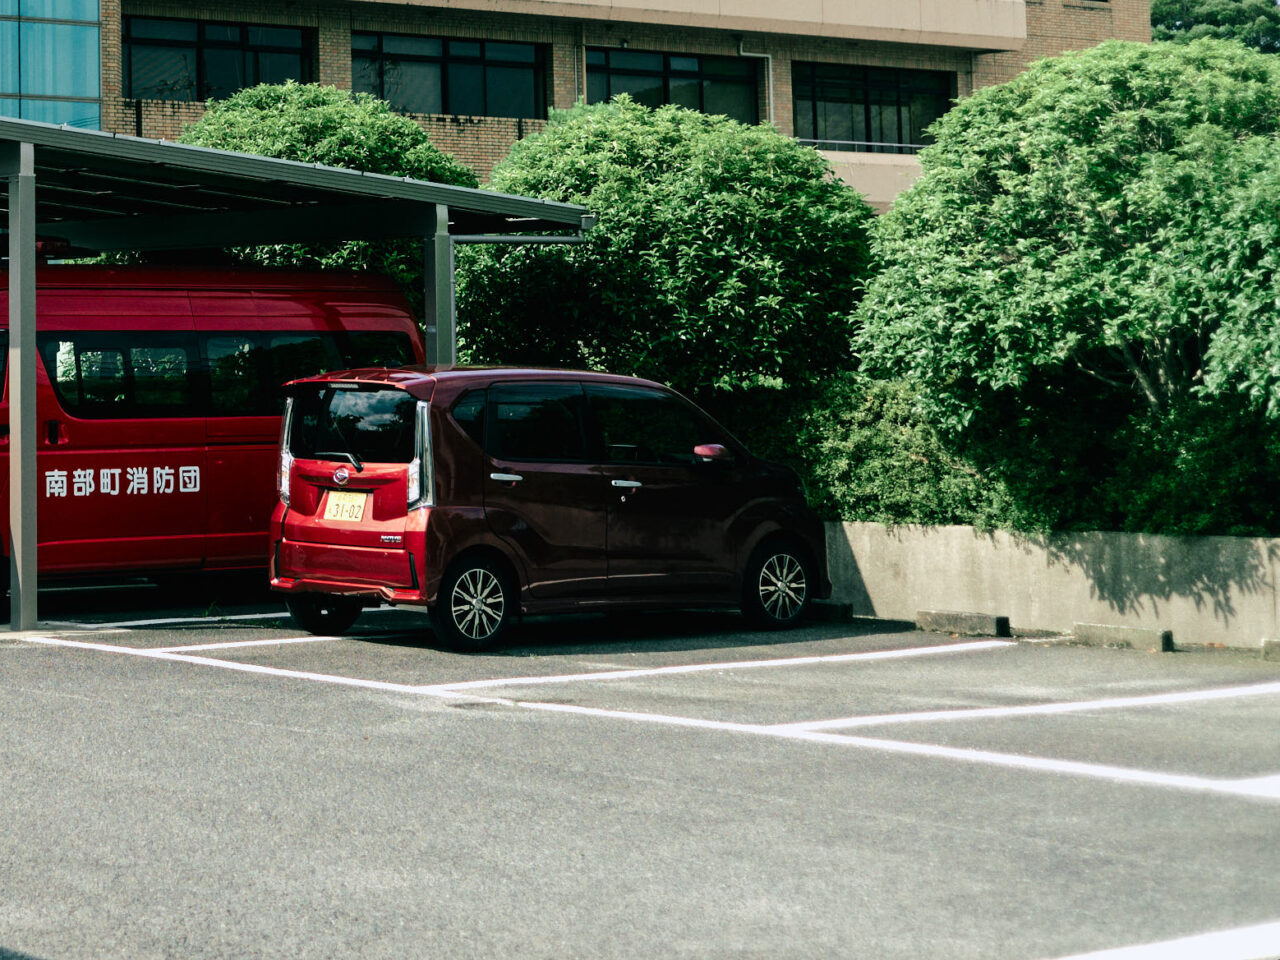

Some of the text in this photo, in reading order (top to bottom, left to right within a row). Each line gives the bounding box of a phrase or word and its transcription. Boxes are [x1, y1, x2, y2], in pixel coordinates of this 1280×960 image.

[44, 465, 201, 498] 南部町消防団
